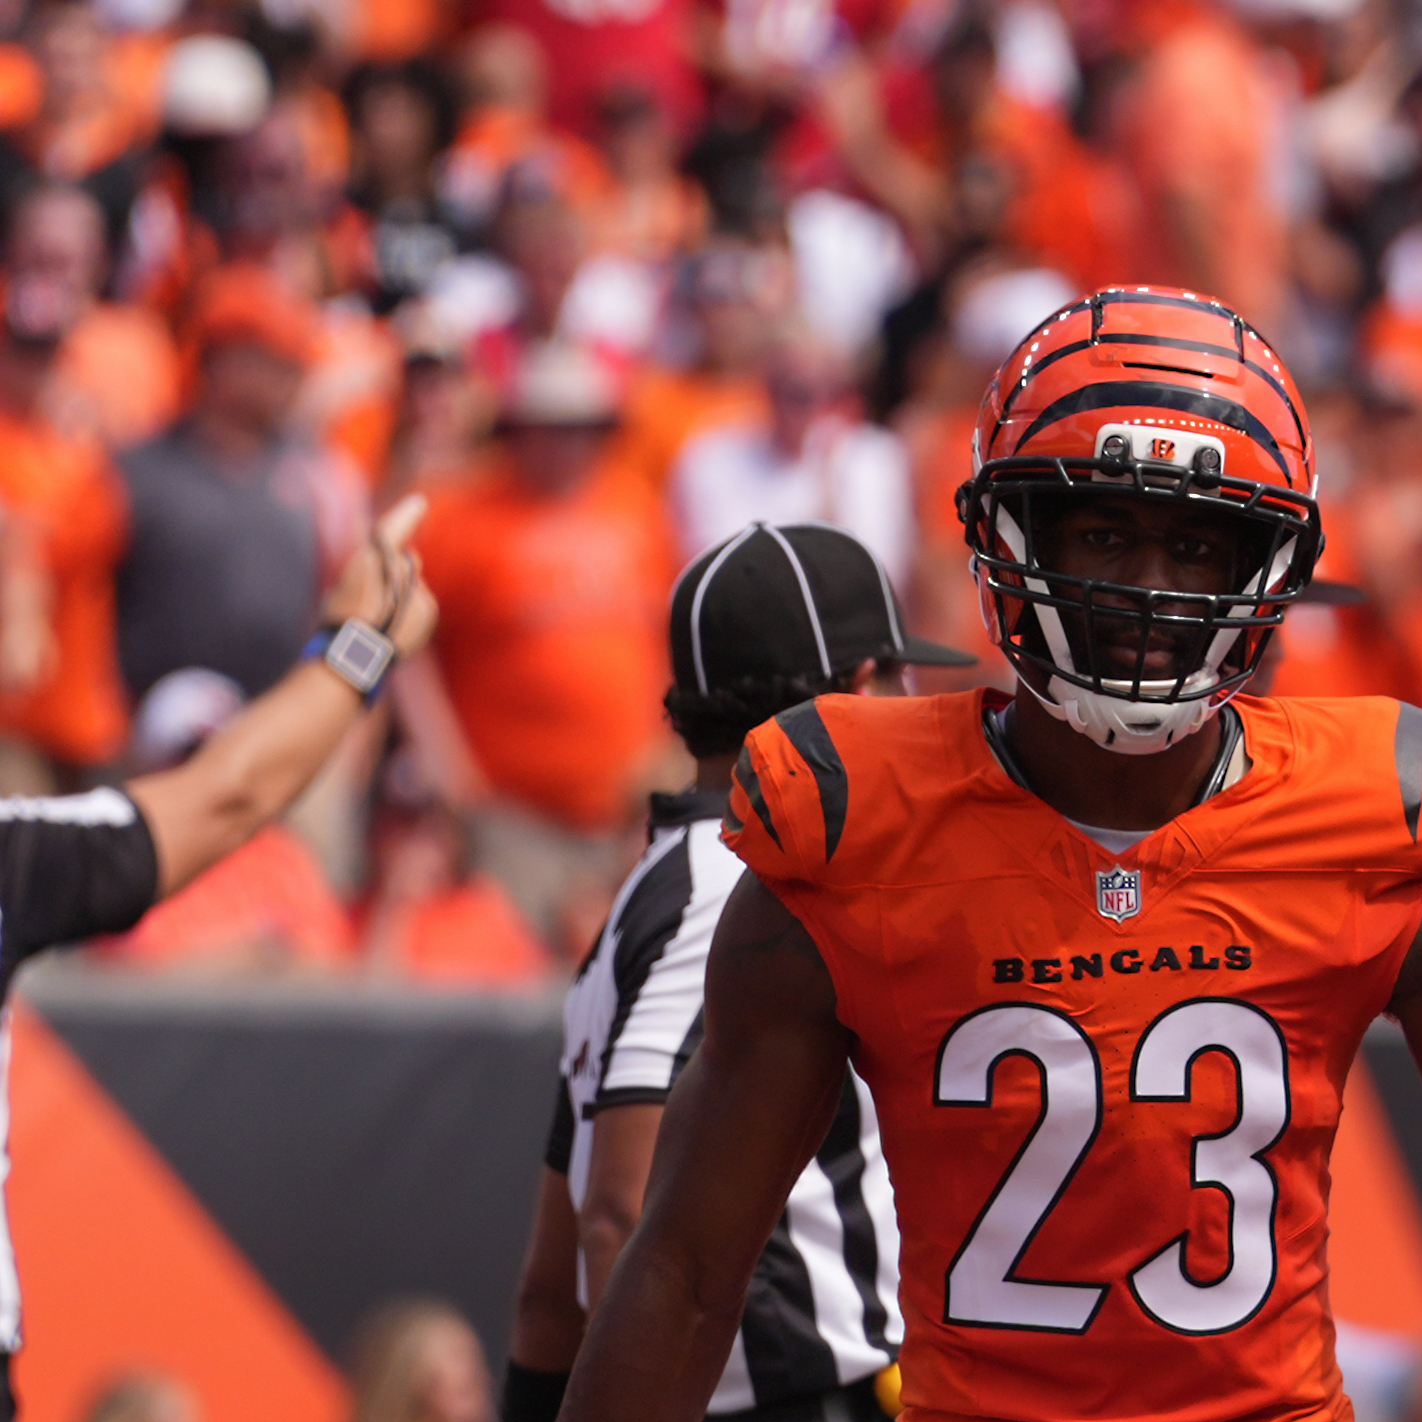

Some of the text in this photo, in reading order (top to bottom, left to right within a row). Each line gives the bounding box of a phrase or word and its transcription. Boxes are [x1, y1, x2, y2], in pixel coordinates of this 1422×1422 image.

[1104, 891, 1135, 912] NFL
[993, 946, 1252, 984] BENGALS
[932, 996, 1290, 1336] 23
